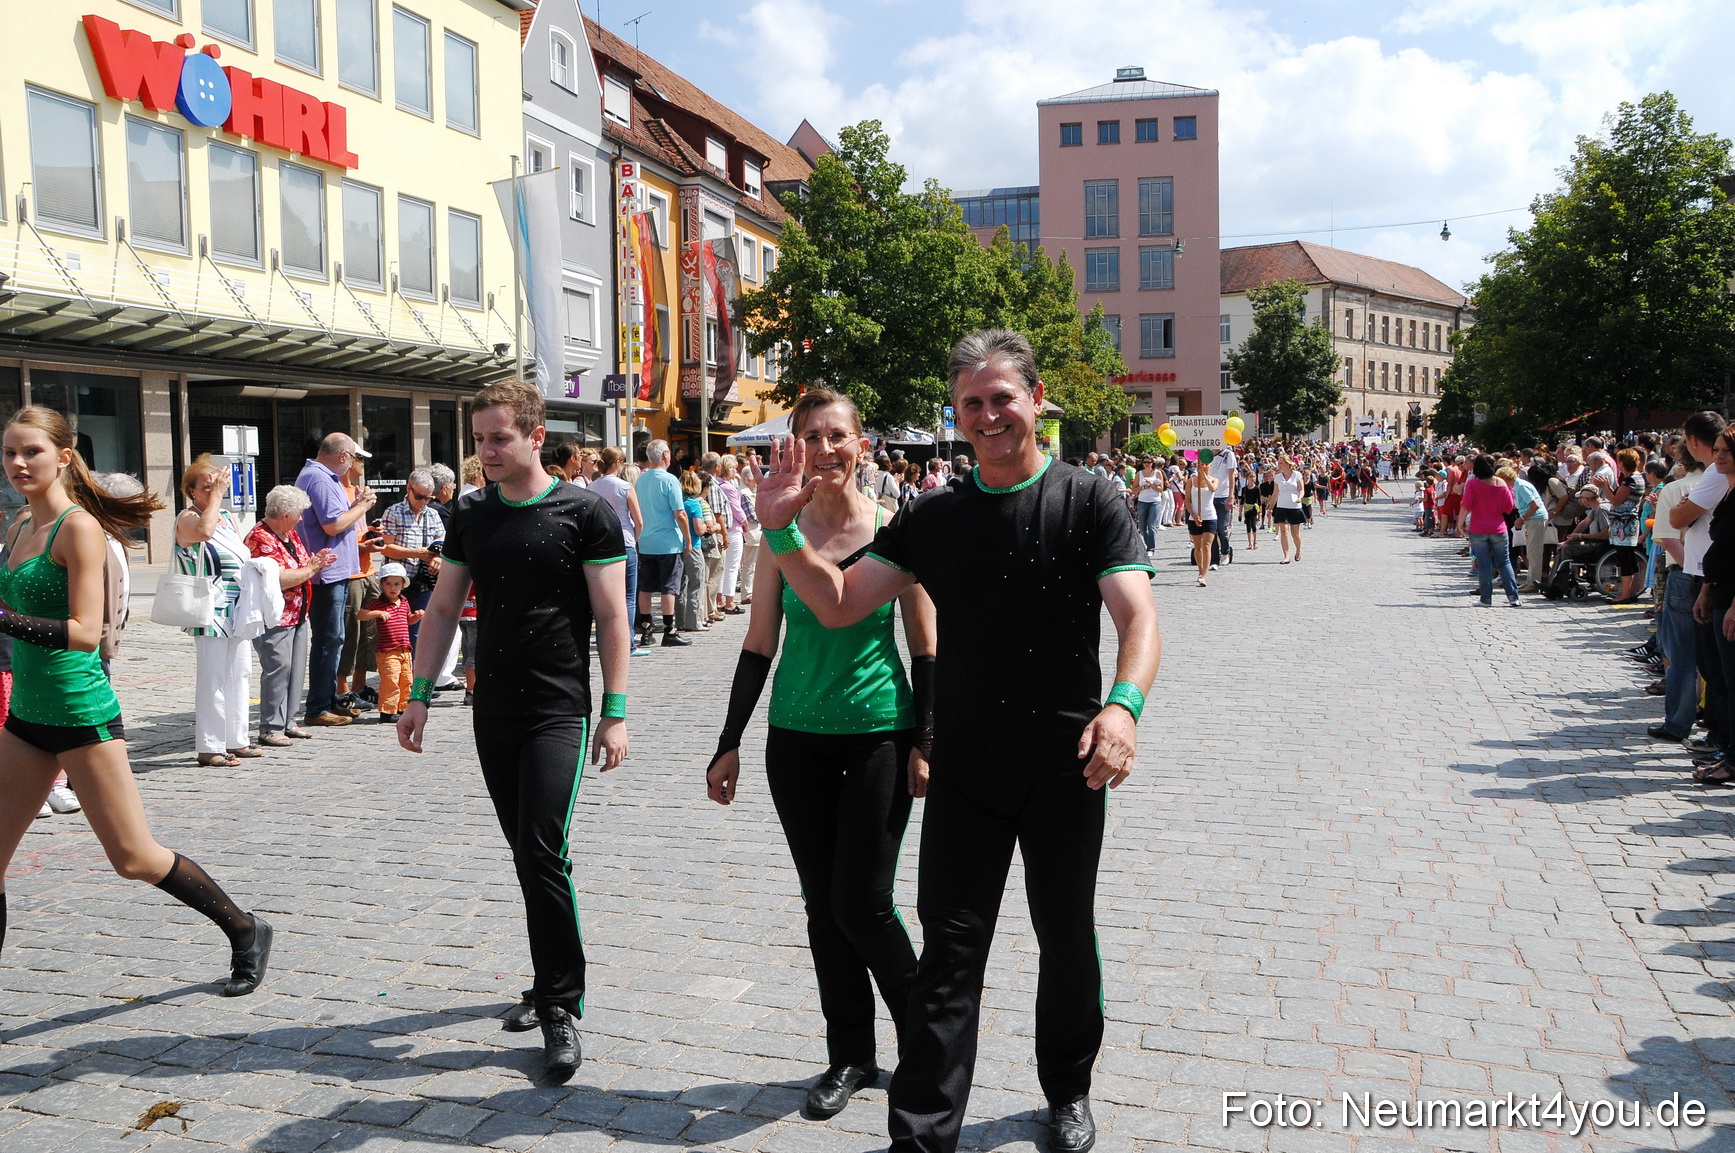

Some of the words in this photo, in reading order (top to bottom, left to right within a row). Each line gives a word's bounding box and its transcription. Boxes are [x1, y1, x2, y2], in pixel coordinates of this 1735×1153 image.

[82, 14, 358, 169] WÖHRL
[622, 327, 640, 339] cfé
[608, 380, 638, 393] libey
[1170, 418, 1227, 427] TURNABTEILUNG
[1193, 429, 1204, 437] SV
[1176, 438, 1221, 447] HÖHENBERG
